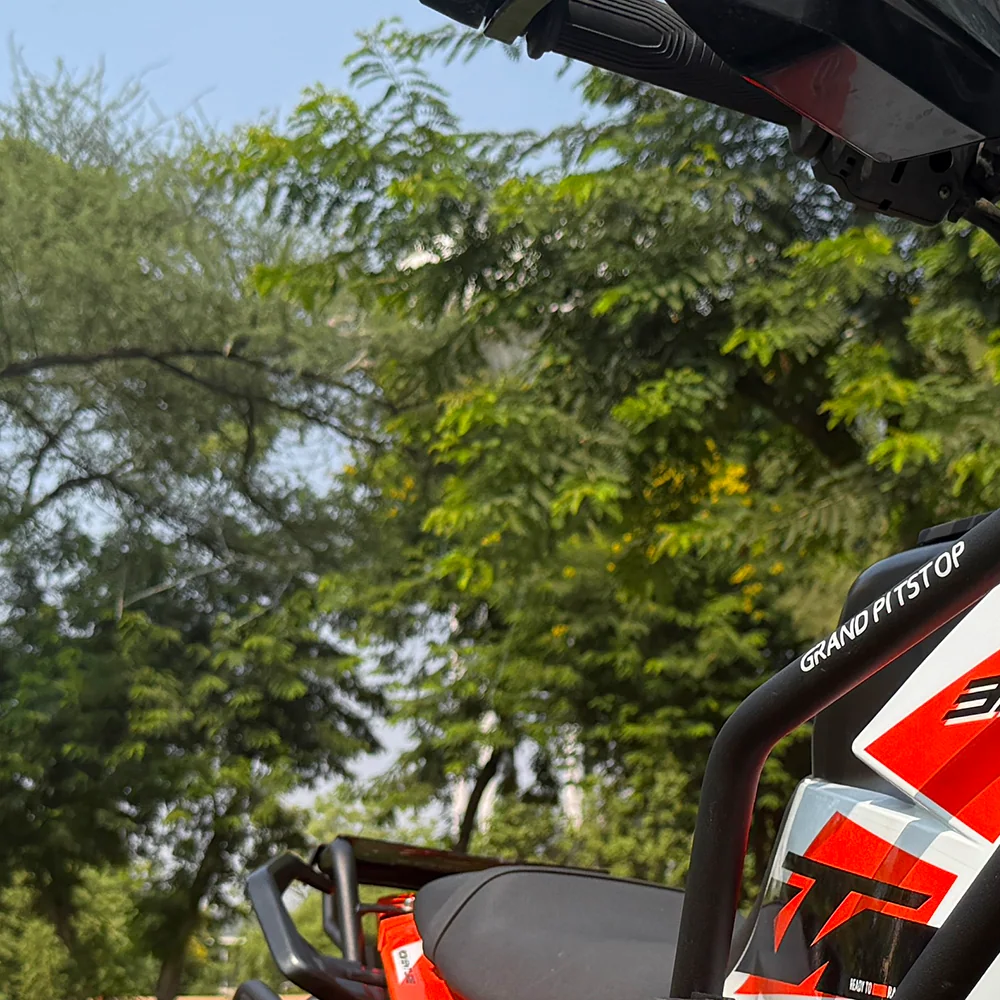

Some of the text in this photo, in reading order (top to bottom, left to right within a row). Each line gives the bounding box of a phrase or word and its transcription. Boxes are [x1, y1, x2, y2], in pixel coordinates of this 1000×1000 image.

[800, 540, 965, 672] GRAND PITSTOP
[849, 977, 865, 993] READY
[865, 981, 873, 995] TO
